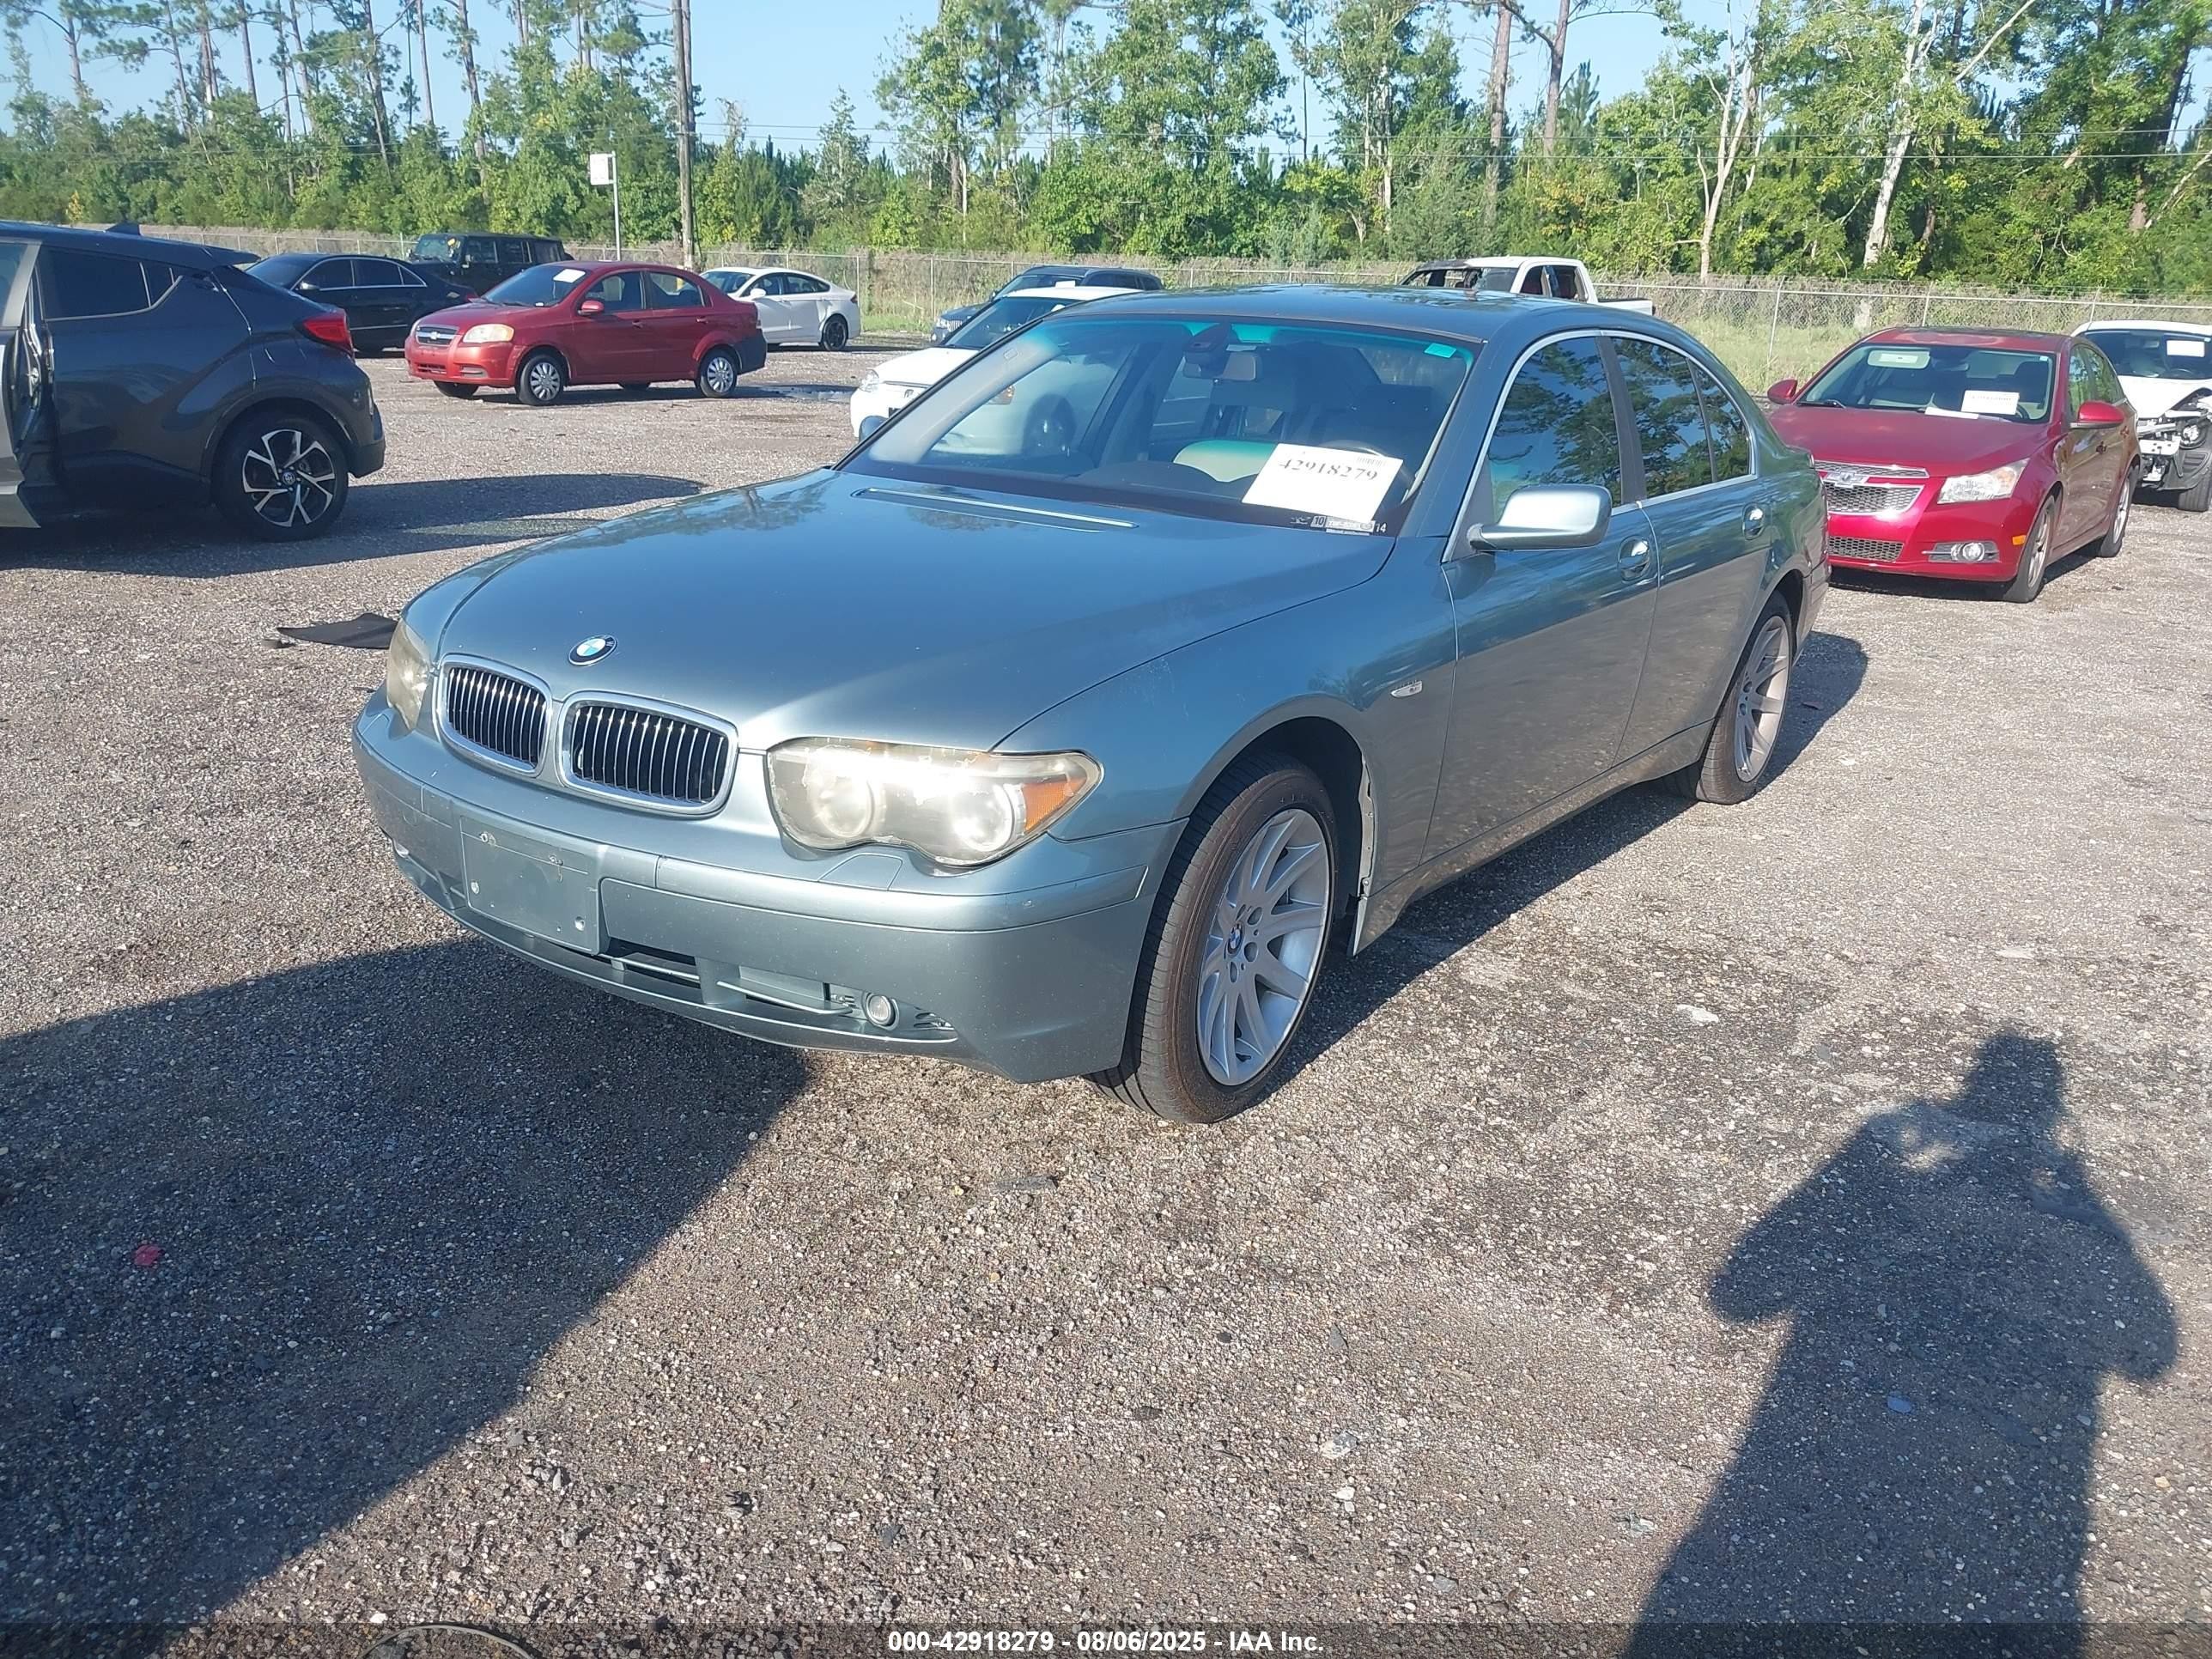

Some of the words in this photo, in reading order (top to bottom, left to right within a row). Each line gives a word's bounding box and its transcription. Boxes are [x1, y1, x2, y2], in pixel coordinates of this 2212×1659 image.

[1279, 458, 1379, 482] 42918279
[1315, 515, 1325, 526] 10
[1375, 523, 1387, 533] 14
